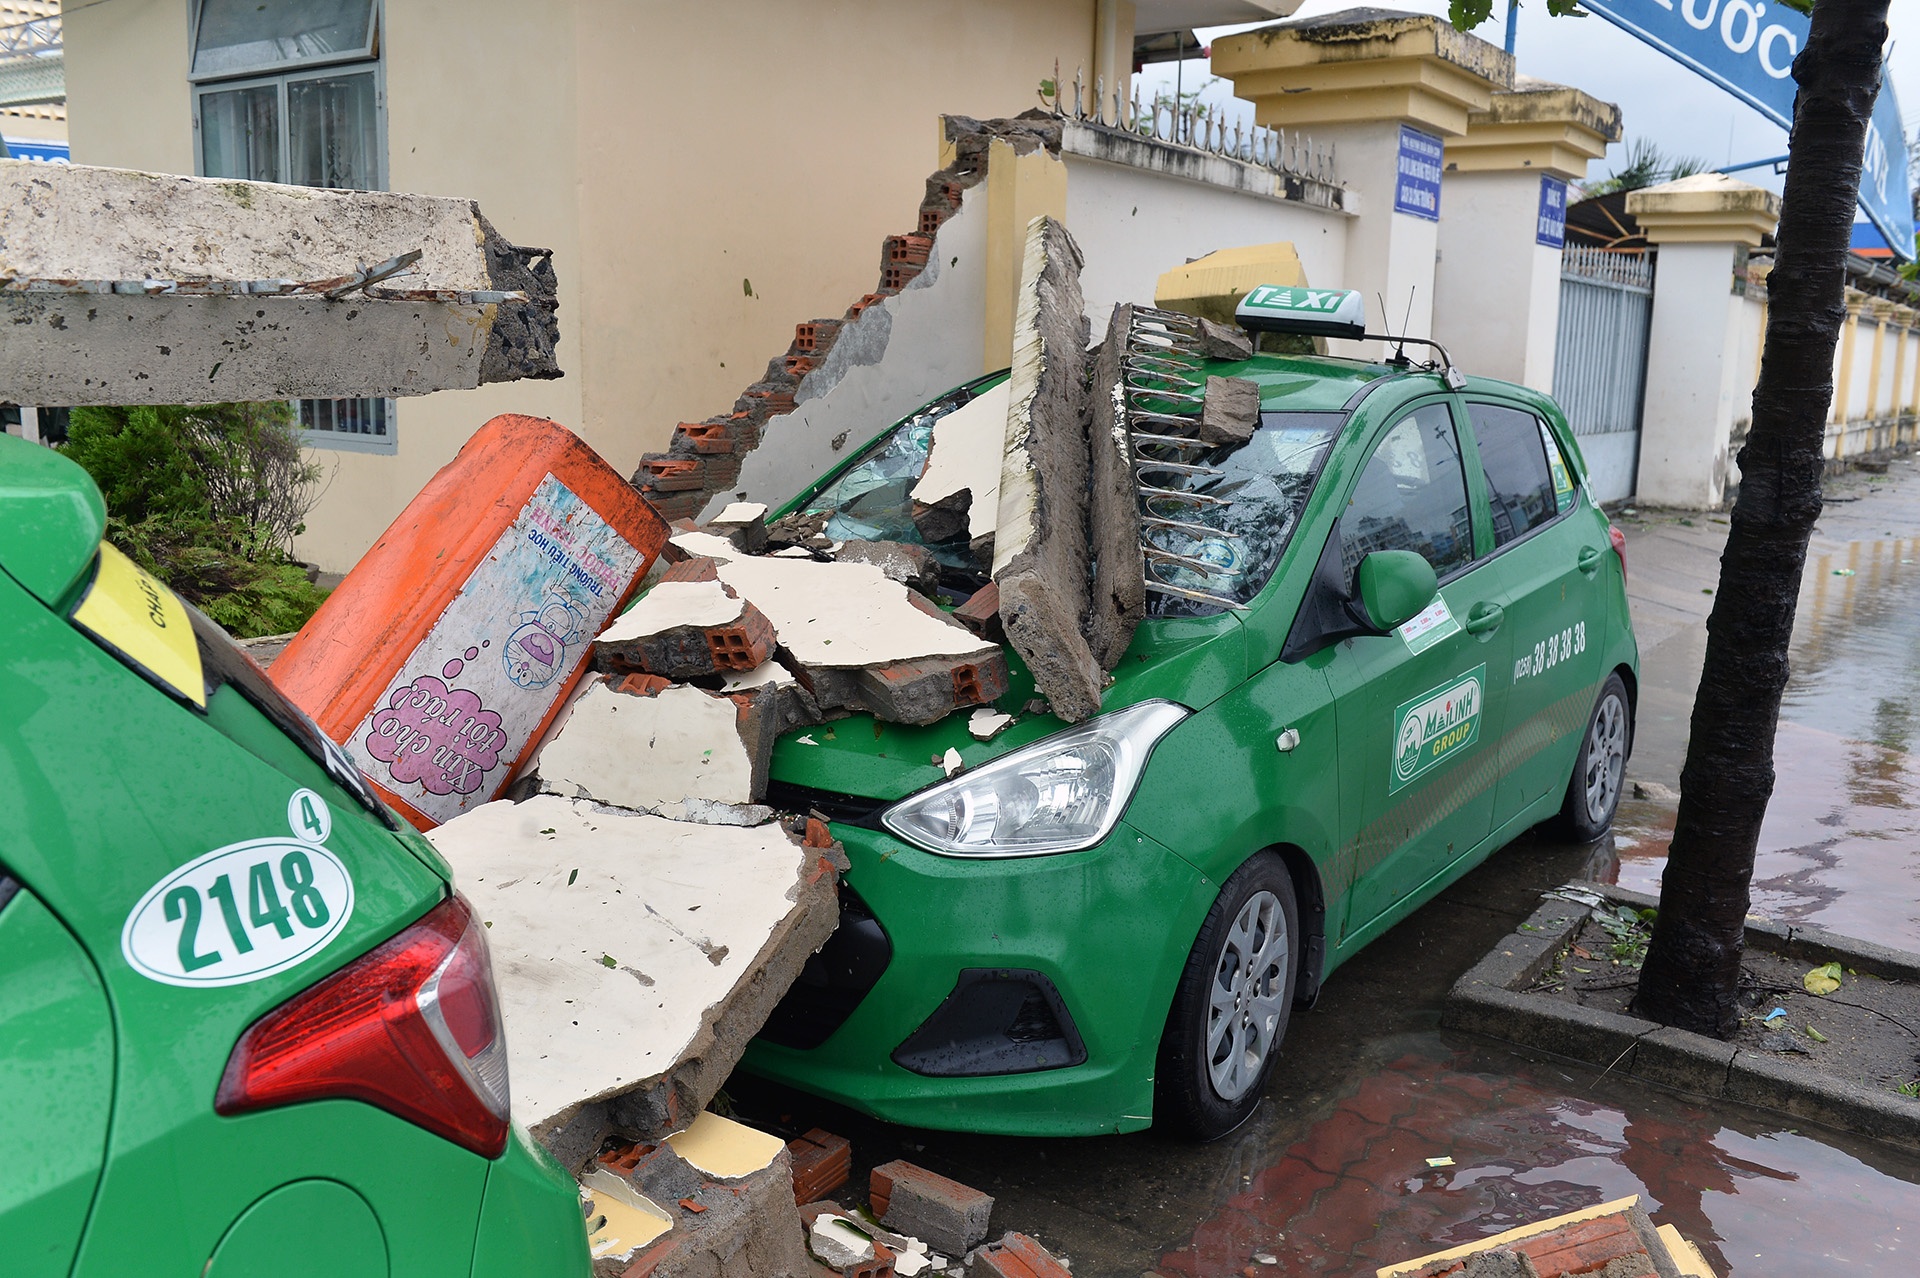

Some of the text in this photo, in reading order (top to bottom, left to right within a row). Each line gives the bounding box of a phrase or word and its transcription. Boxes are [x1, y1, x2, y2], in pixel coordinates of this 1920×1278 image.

[527, 528, 604, 598] TRƯỜNG TIỂU HỌC
[1532, 640, 1546, 677] 38
[1546, 633, 1560, 669] 38
[1560, 626, 1573, 662] 38
[1573, 620, 1586, 655] 38
[393, 683, 500, 754] tôi rác!
[1432, 722, 1470, 756] GROUP
[379, 717, 483, 791] Xin cho
[300, 795, 323, 837] 4
[163, 850, 331, 973] 2148
